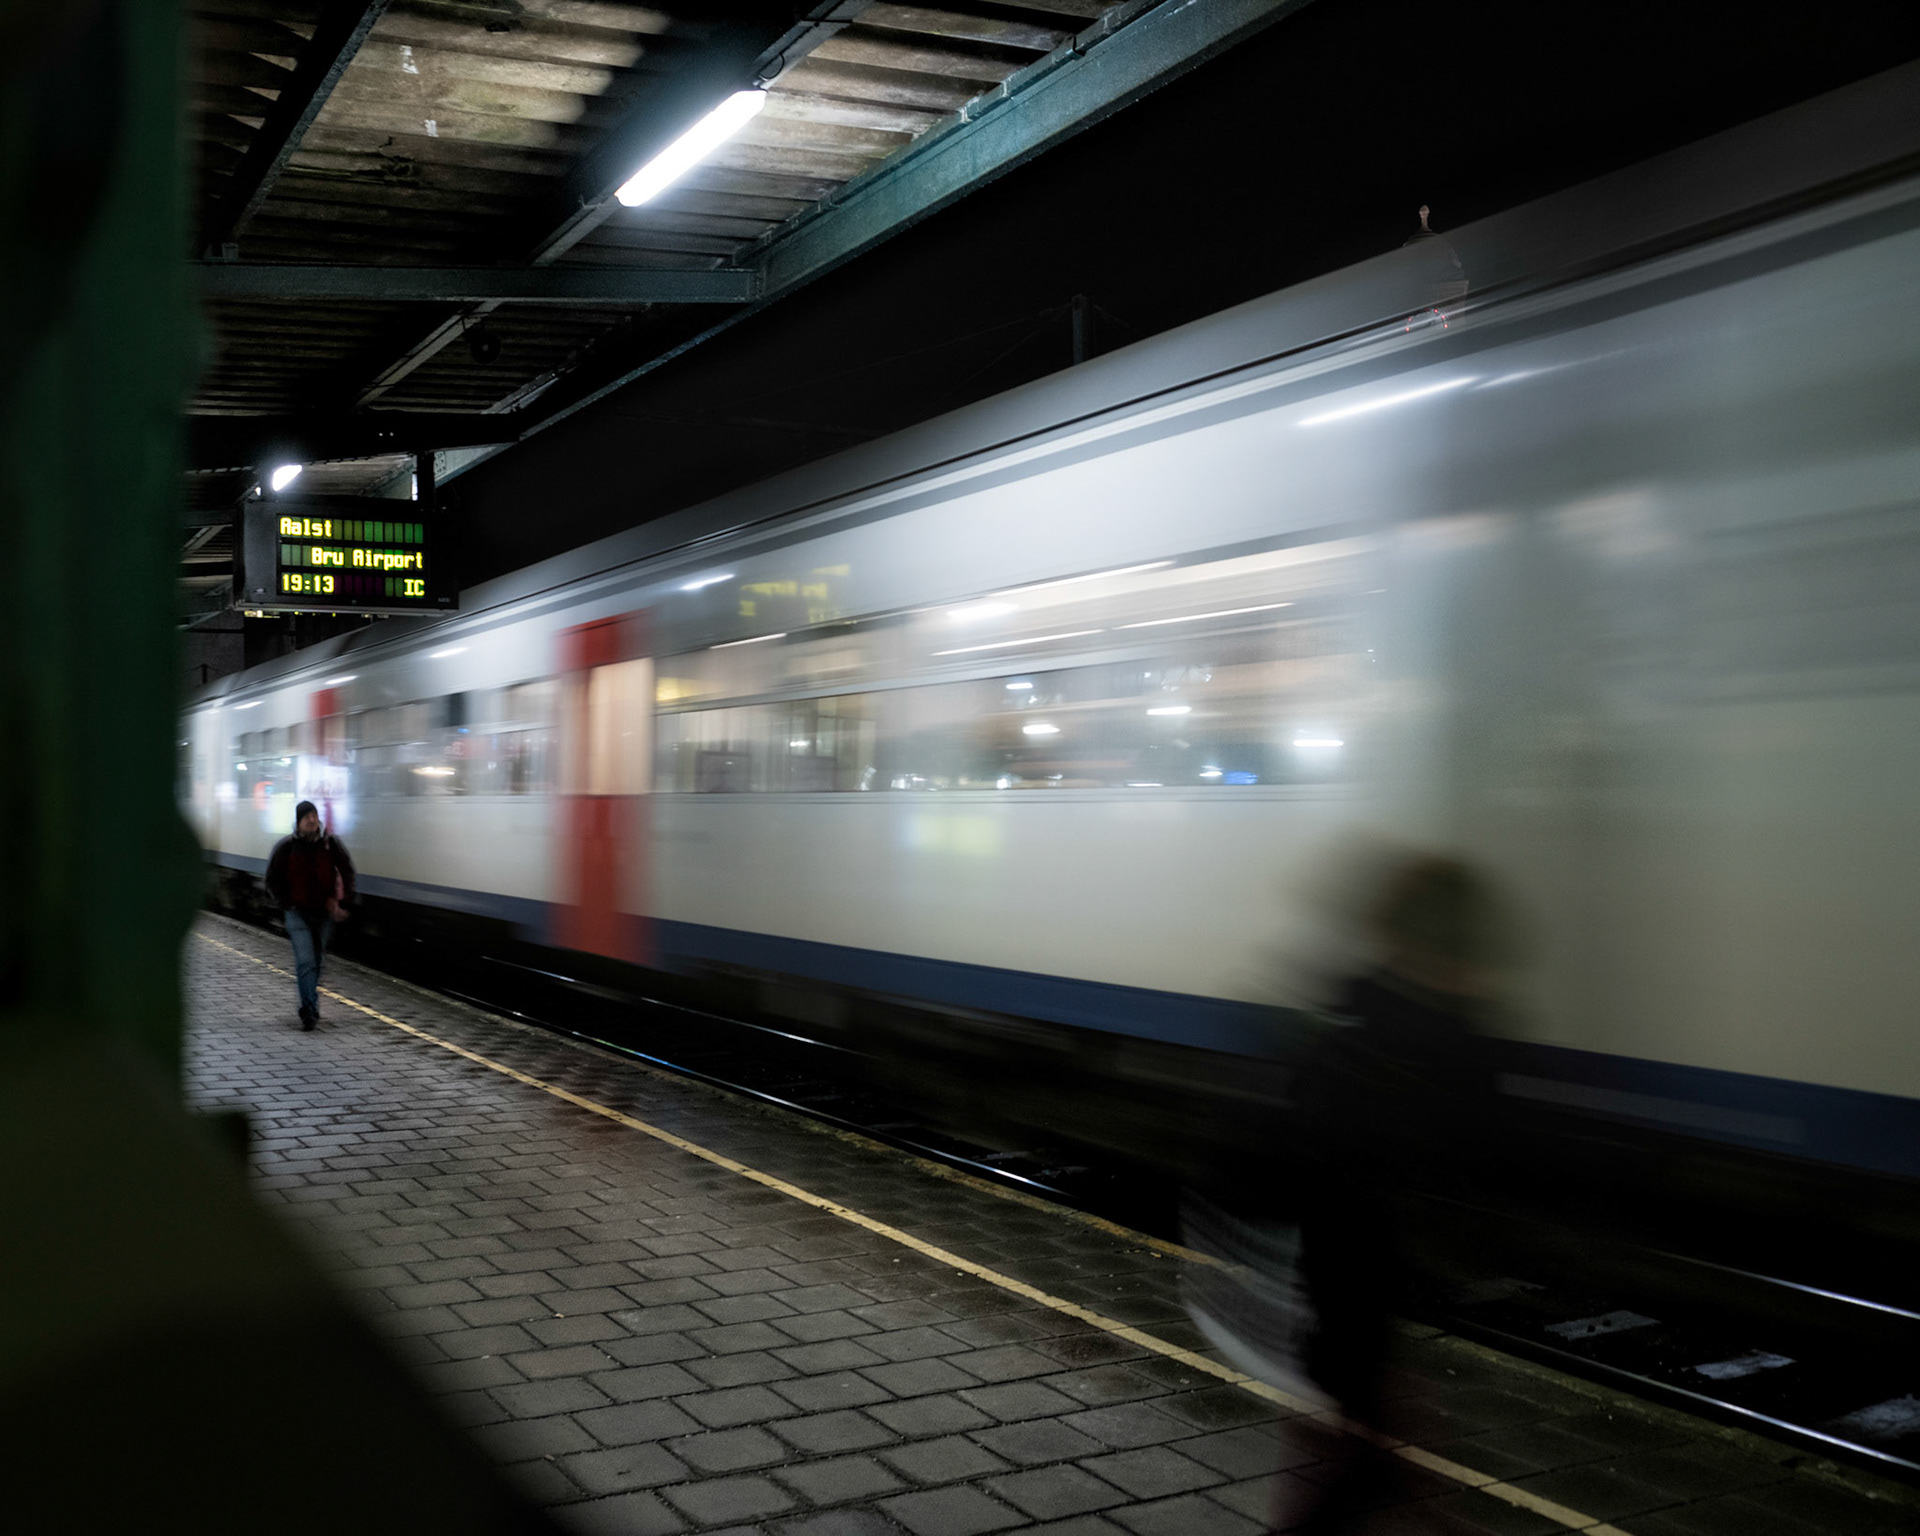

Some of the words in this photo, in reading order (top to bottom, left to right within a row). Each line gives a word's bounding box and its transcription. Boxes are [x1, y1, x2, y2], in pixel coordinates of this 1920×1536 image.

[280, 517, 332, 537] Aalst
[311, 547, 344, 566] Bru
[352, 549, 423, 571] Airport
[282, 573, 335, 593] 19:13
[403, 578, 425, 596] IC
